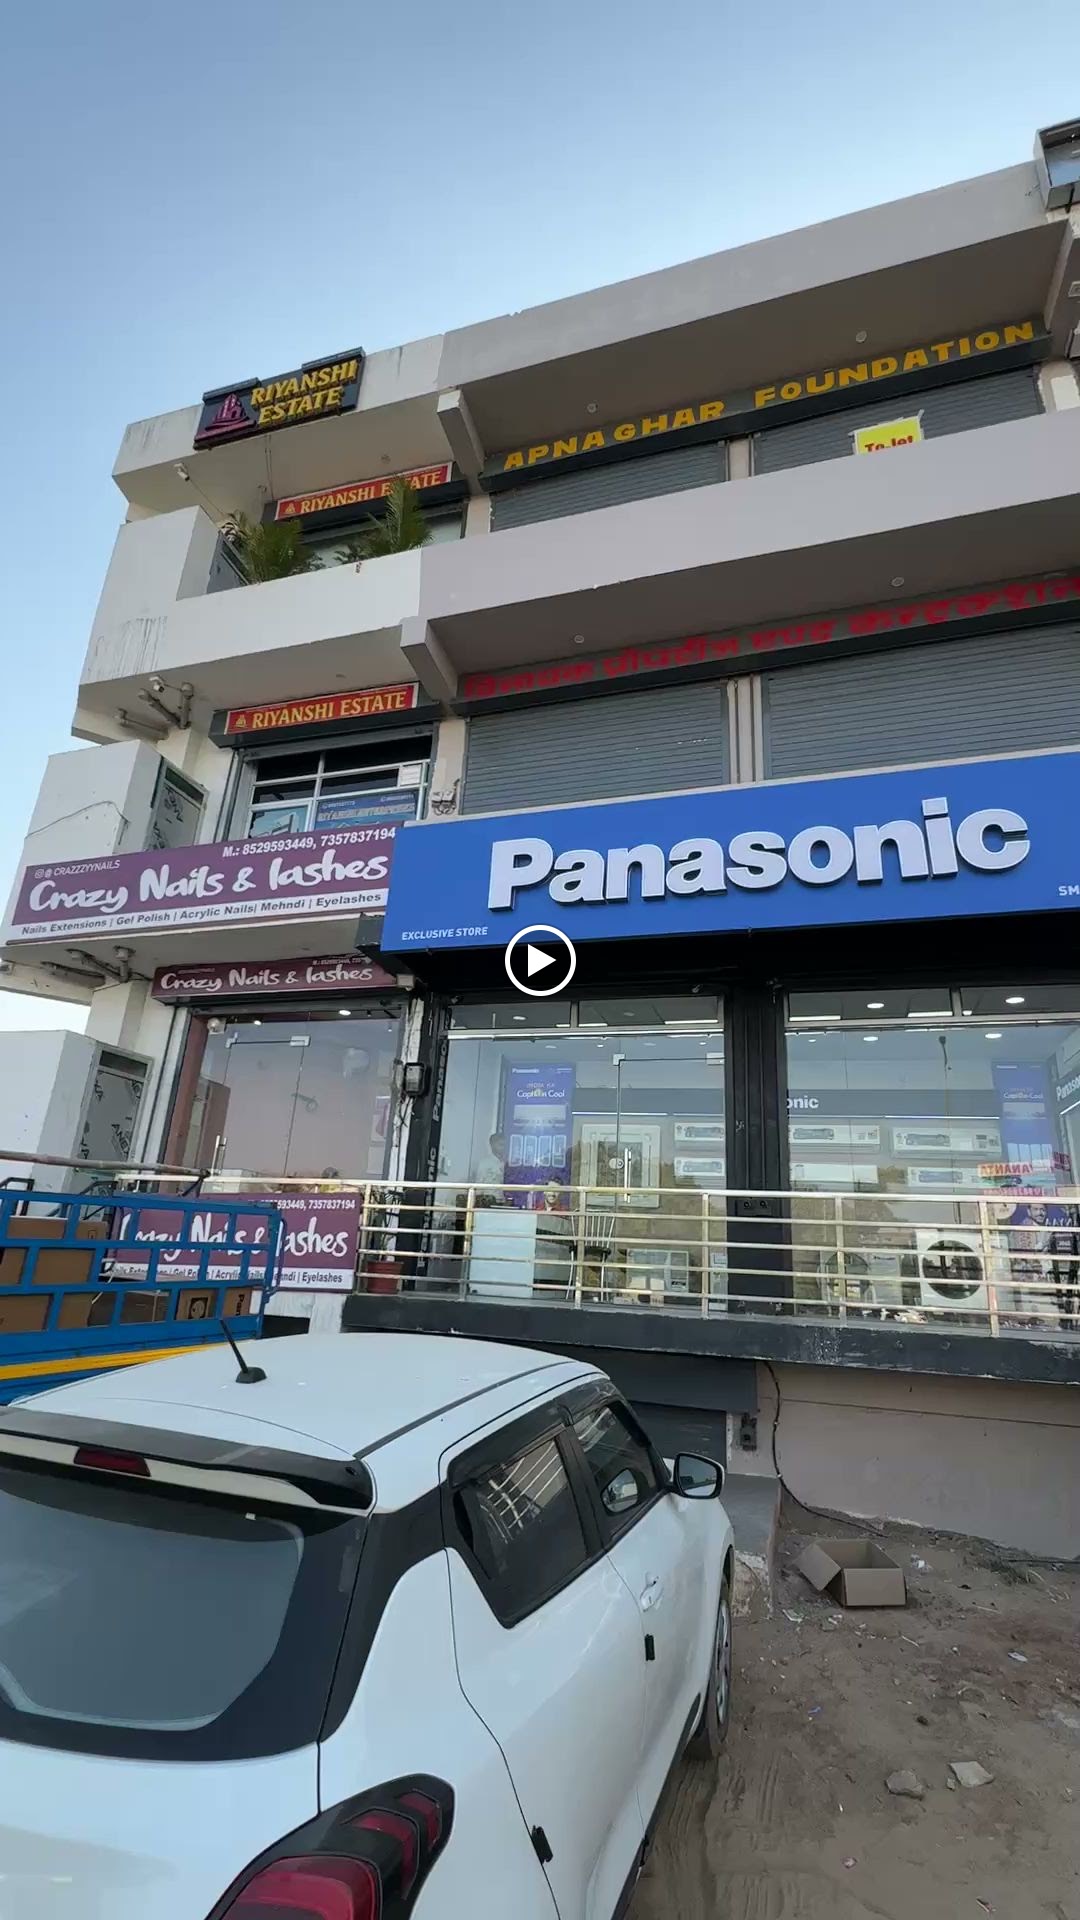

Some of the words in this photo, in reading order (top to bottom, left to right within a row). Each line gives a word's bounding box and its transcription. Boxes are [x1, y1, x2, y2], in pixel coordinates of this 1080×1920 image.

[250, 359, 358, 406] RIYANSHI
[503, 401, 725, 471] APNAGHAR
[754, 320, 1034, 408] FOUNDATION
[258, 385, 344, 425] ESTATE
[300, 485, 375, 514] RIYANSHI
[252, 702, 334, 729] RIYANSHI
[340, 691, 407, 716] ESTATE
[242, 836, 317, 855] 8529593449,
[321, 827, 396, 846] 7357837194
[487, 797, 1032, 912] Panasonic
[29, 880, 129, 914] Crazy
[139, 864, 225, 902] Nails
[232, 867, 256, 892] &
[269, 849, 388, 891] lashes
[21, 926, 47, 936] Nails
[50, 919, 107, 933] Extensions
[116, 915, 134, 926] Gel
[137, 912, 171, 924] Polish
[180, 907, 220, 922] Acrylic
[260, 900, 305, 912] Mehndi
[316, 893, 382, 907] Eyelashes
[402, 929, 454, 941] EXCLUSIVE
[455, 927, 488, 937] STORE
[160, 972, 222, 992] Crazy
[229, 968, 280, 987] Nails
[285, 971, 298, 984] &
[306, 963, 373, 984] lashes
[547, 1090, 566, 1098] Cool
[309, 1199, 356, 1209] 7357837194
[302, 1271, 343, 1284] Eyelashes
